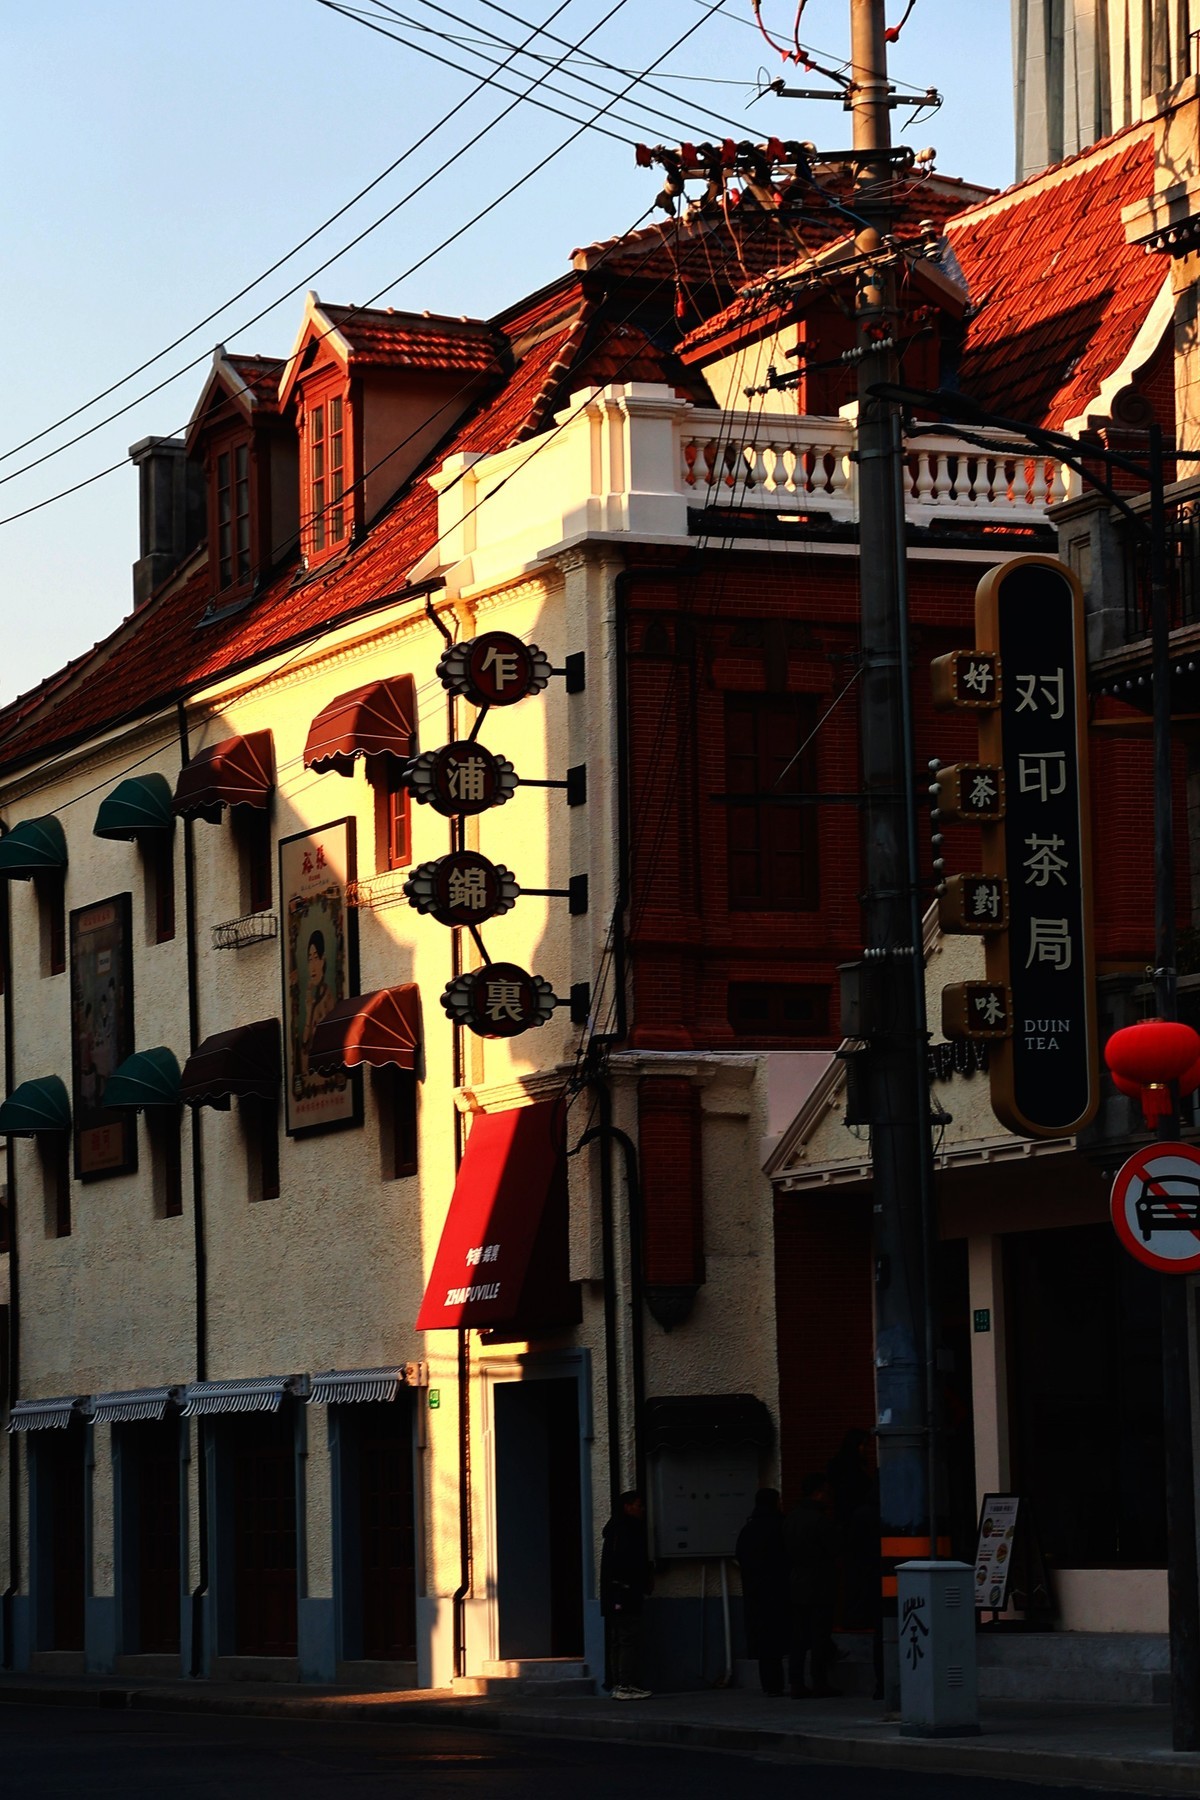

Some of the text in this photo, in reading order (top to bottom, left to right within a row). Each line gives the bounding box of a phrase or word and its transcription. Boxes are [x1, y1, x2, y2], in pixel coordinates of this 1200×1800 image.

[1015, 666, 1071, 972] 对印茶局
[1023, 1019, 1070, 1034] DUIN
[1023, 1037, 1061, 1051] TEA
[444, 1282, 501, 1307] ZHAPUVILLE
